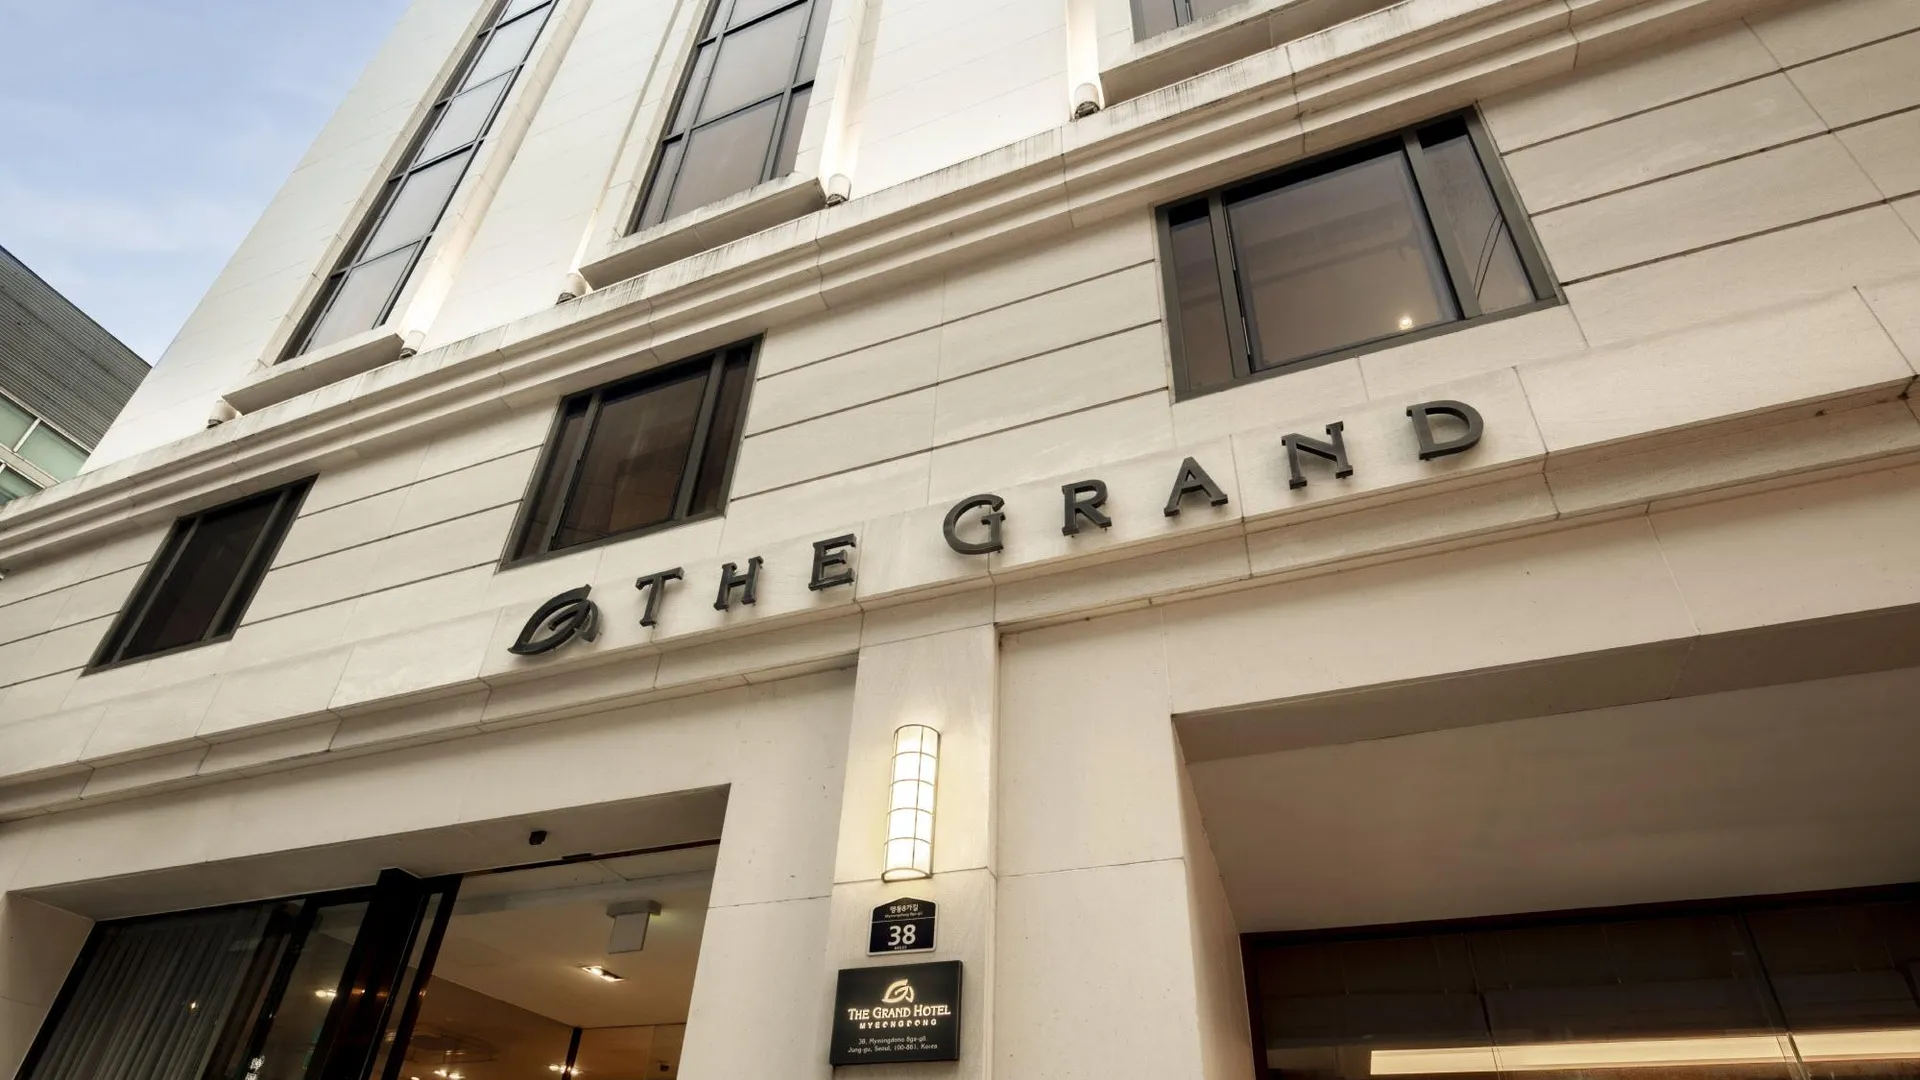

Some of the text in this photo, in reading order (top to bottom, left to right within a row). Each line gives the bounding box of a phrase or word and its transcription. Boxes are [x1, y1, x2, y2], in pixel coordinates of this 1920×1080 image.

[635, 399, 1485, 627] THE GRAND
[888, 924, 916, 946] 38
[848, 1004, 951, 1020] THE GRAND HOTEL
[859, 1018, 937, 1029] MYEONGDONG
